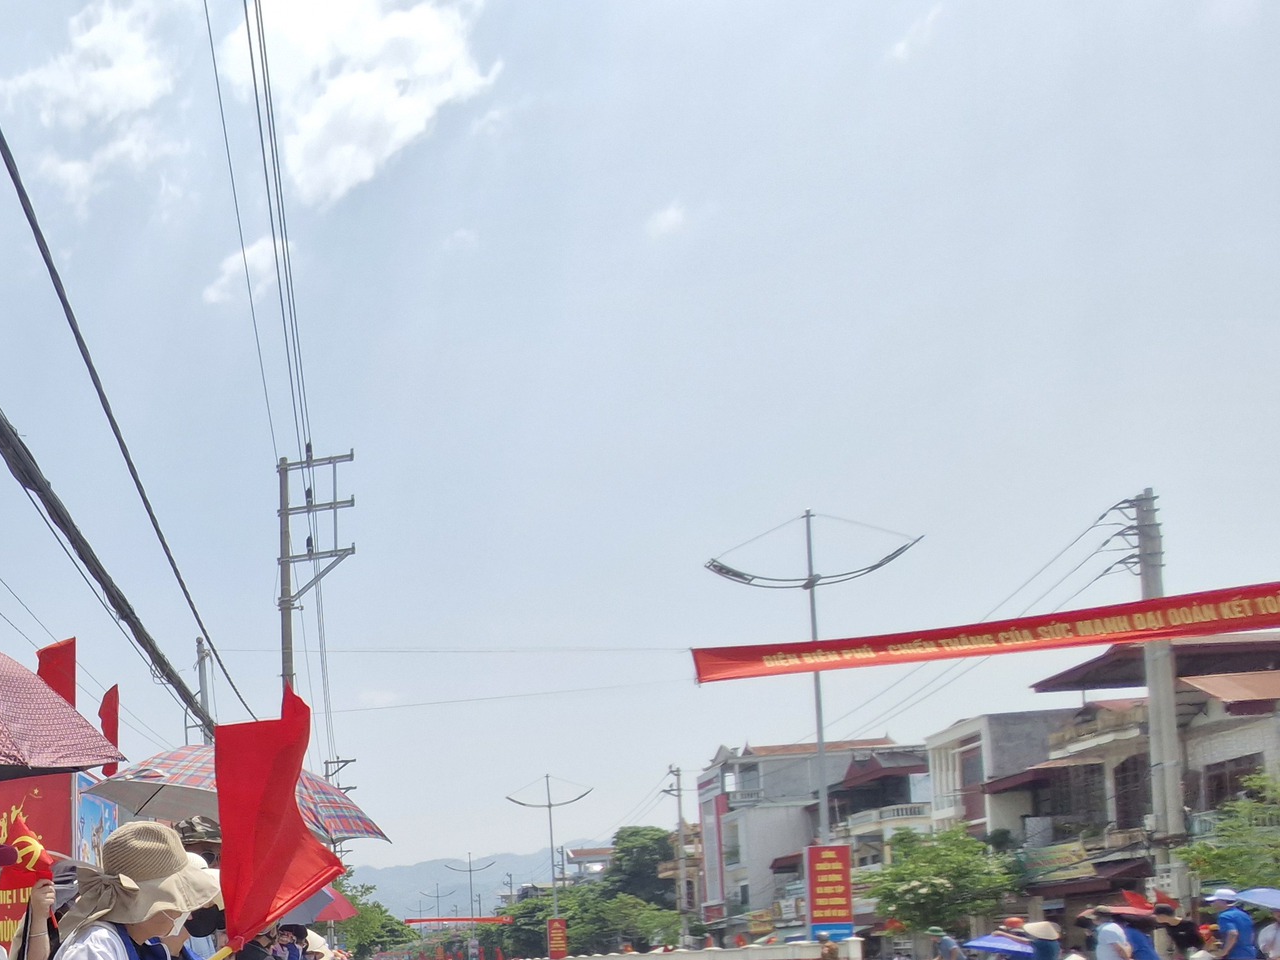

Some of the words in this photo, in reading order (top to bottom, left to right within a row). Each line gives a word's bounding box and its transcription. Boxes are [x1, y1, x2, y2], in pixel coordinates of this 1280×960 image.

[998, 627, 1034, 645] CỦA
[1036, 620, 1074, 640] SỨC
[1219, 595, 1253, 619] KẾT
